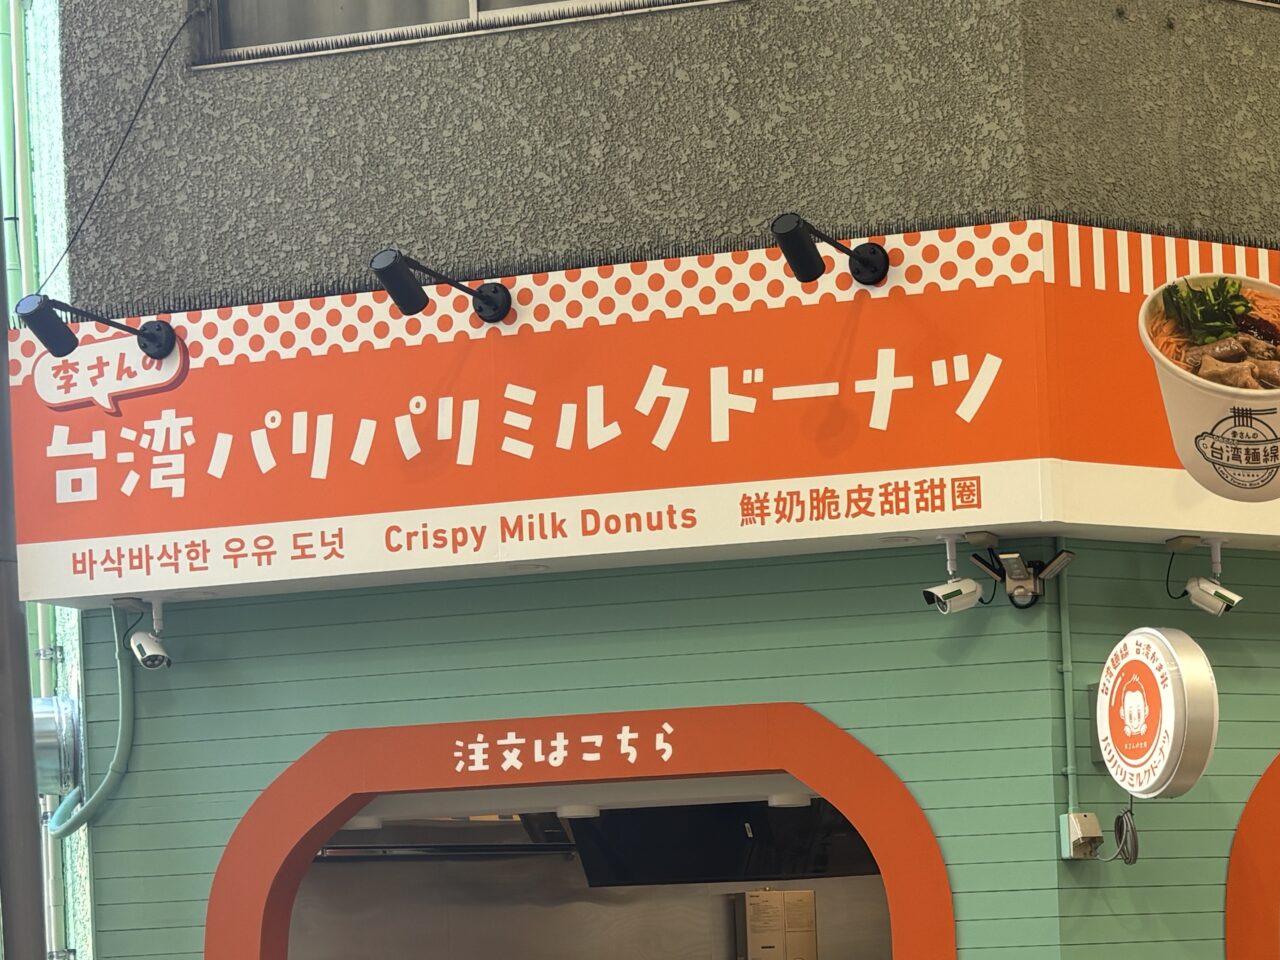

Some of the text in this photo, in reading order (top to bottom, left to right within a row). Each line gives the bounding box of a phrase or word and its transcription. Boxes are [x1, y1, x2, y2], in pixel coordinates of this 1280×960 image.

[51, 352, 163, 395] 李さんの
[46, 348, 1003, 503] 台湾パリパリミルクドーナツ
[739, 475, 982, 527] 鮮奶脆皮甜甜圈
[72, 527, 345, 580] 바삭바삭한 우유 도넛
[385, 504, 697, 554] Crispy Milk Donuts
[453, 721, 674, 772] 注文はこちら
